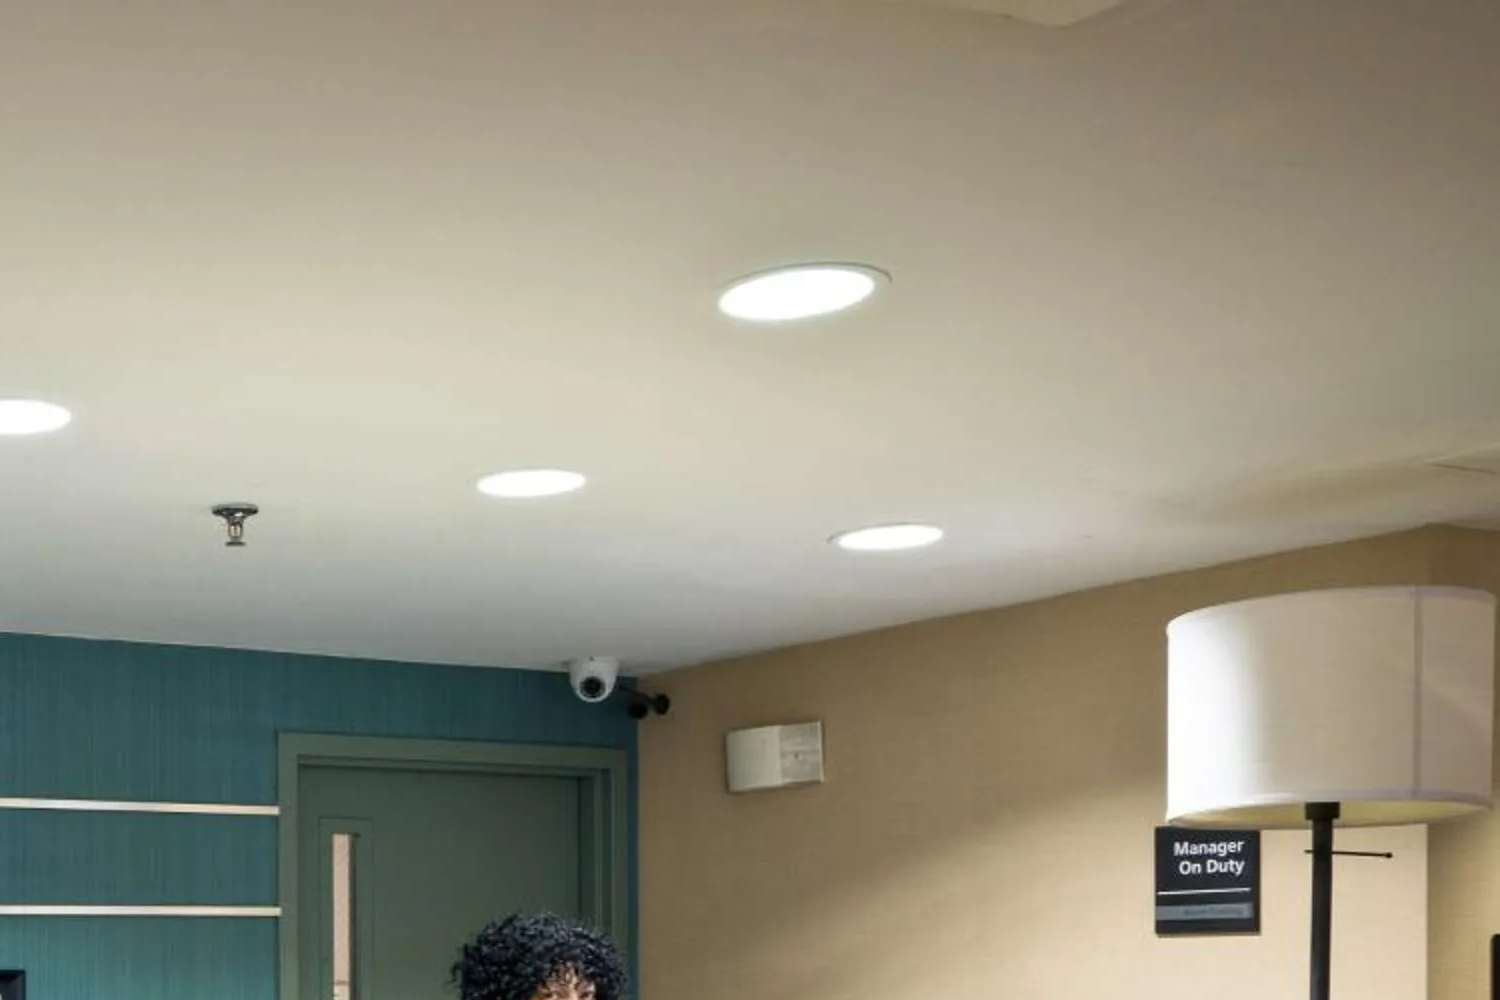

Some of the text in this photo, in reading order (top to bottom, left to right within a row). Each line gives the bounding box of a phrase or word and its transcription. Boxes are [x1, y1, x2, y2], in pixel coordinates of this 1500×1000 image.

[1173, 841, 1245, 857] Manager
[1179, 859, 1245, 877] On Duty
